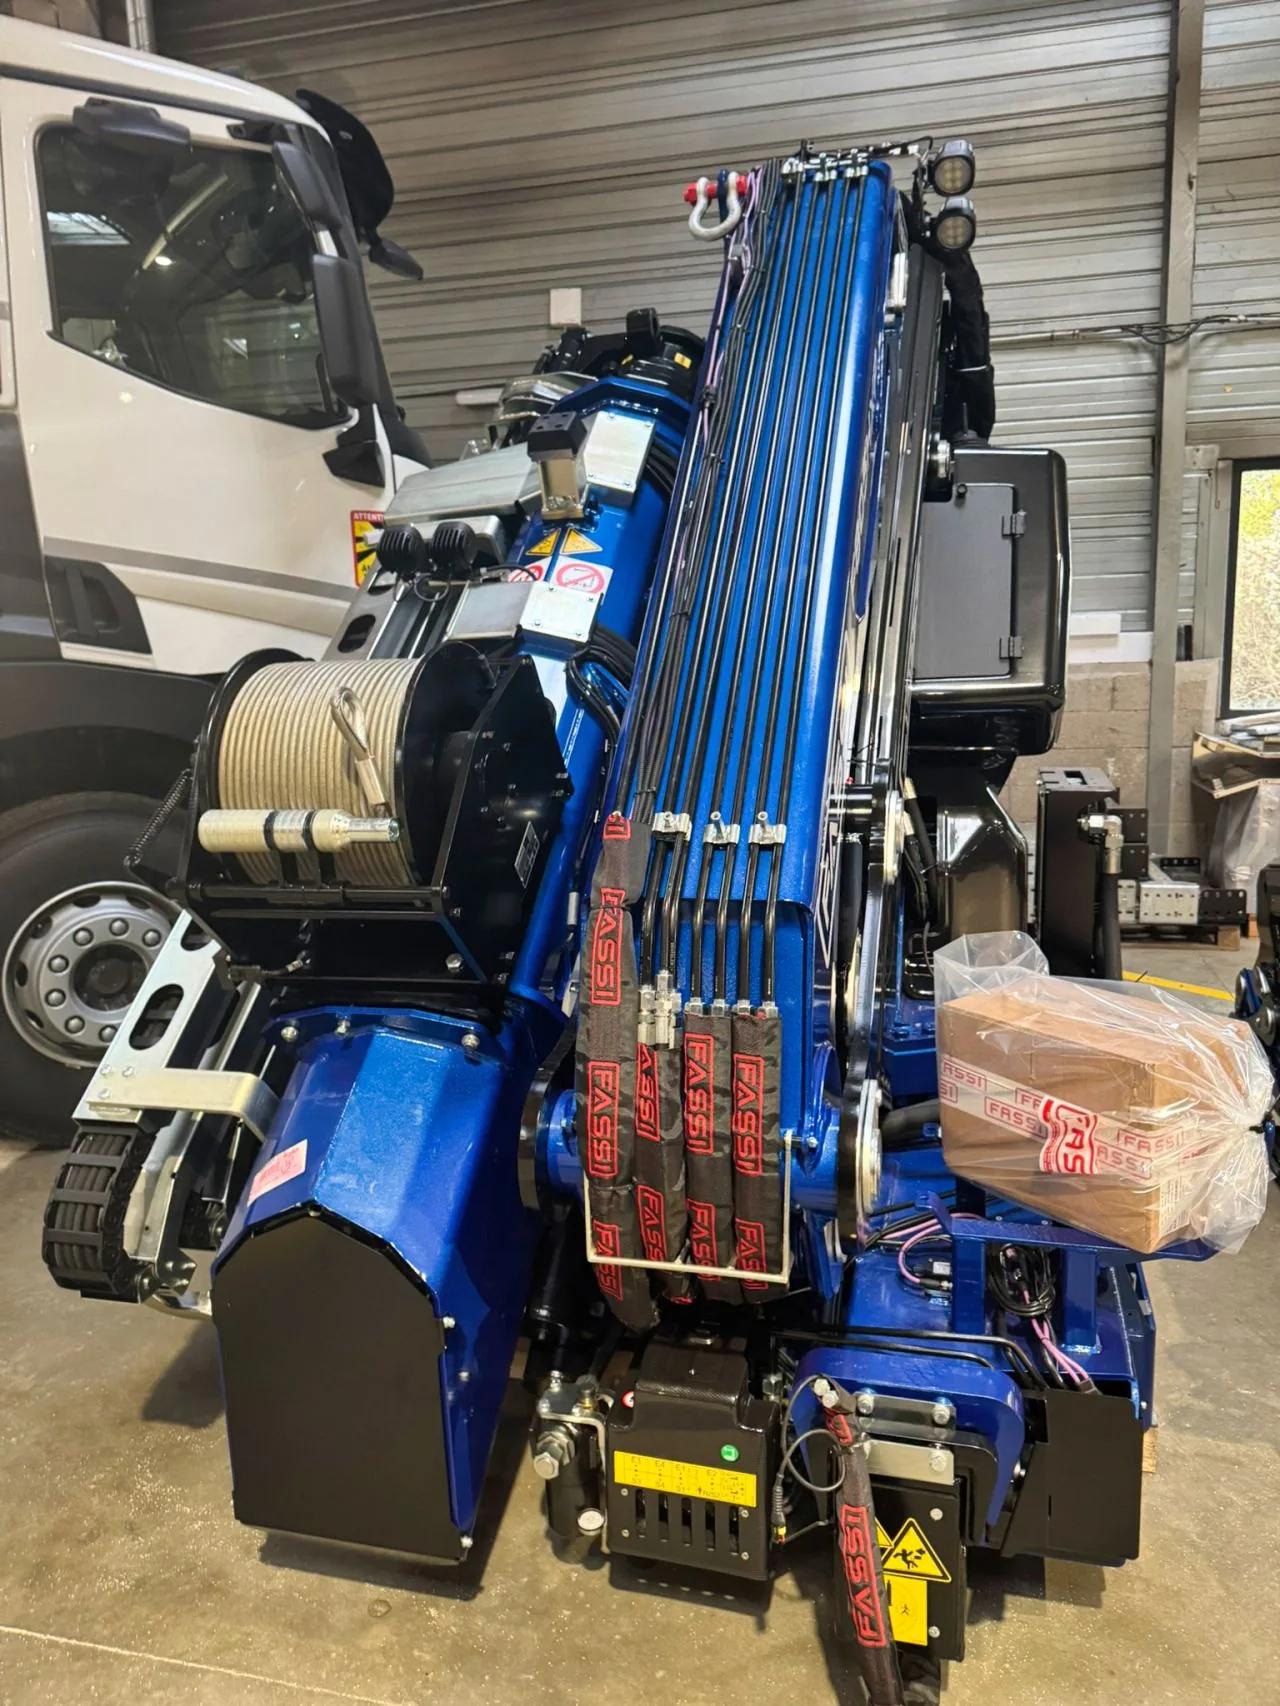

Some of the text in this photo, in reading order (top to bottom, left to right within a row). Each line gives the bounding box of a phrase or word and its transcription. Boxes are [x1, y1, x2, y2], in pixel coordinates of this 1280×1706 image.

[595, 894, 619, 997] FASSI
[592, 1068, 614, 1174] FASSI
[639, 1043, 655, 1133] ASSI
[687, 1041, 708, 1152] FASSI
[735, 1059, 757, 1175] FASSI
[942, 1061, 984, 1087] ASSI
[989, 1102, 1047, 1138] FASSI
[645, 1192, 664, 1263] FASS
[844, 1507, 879, 1639] FASSI
